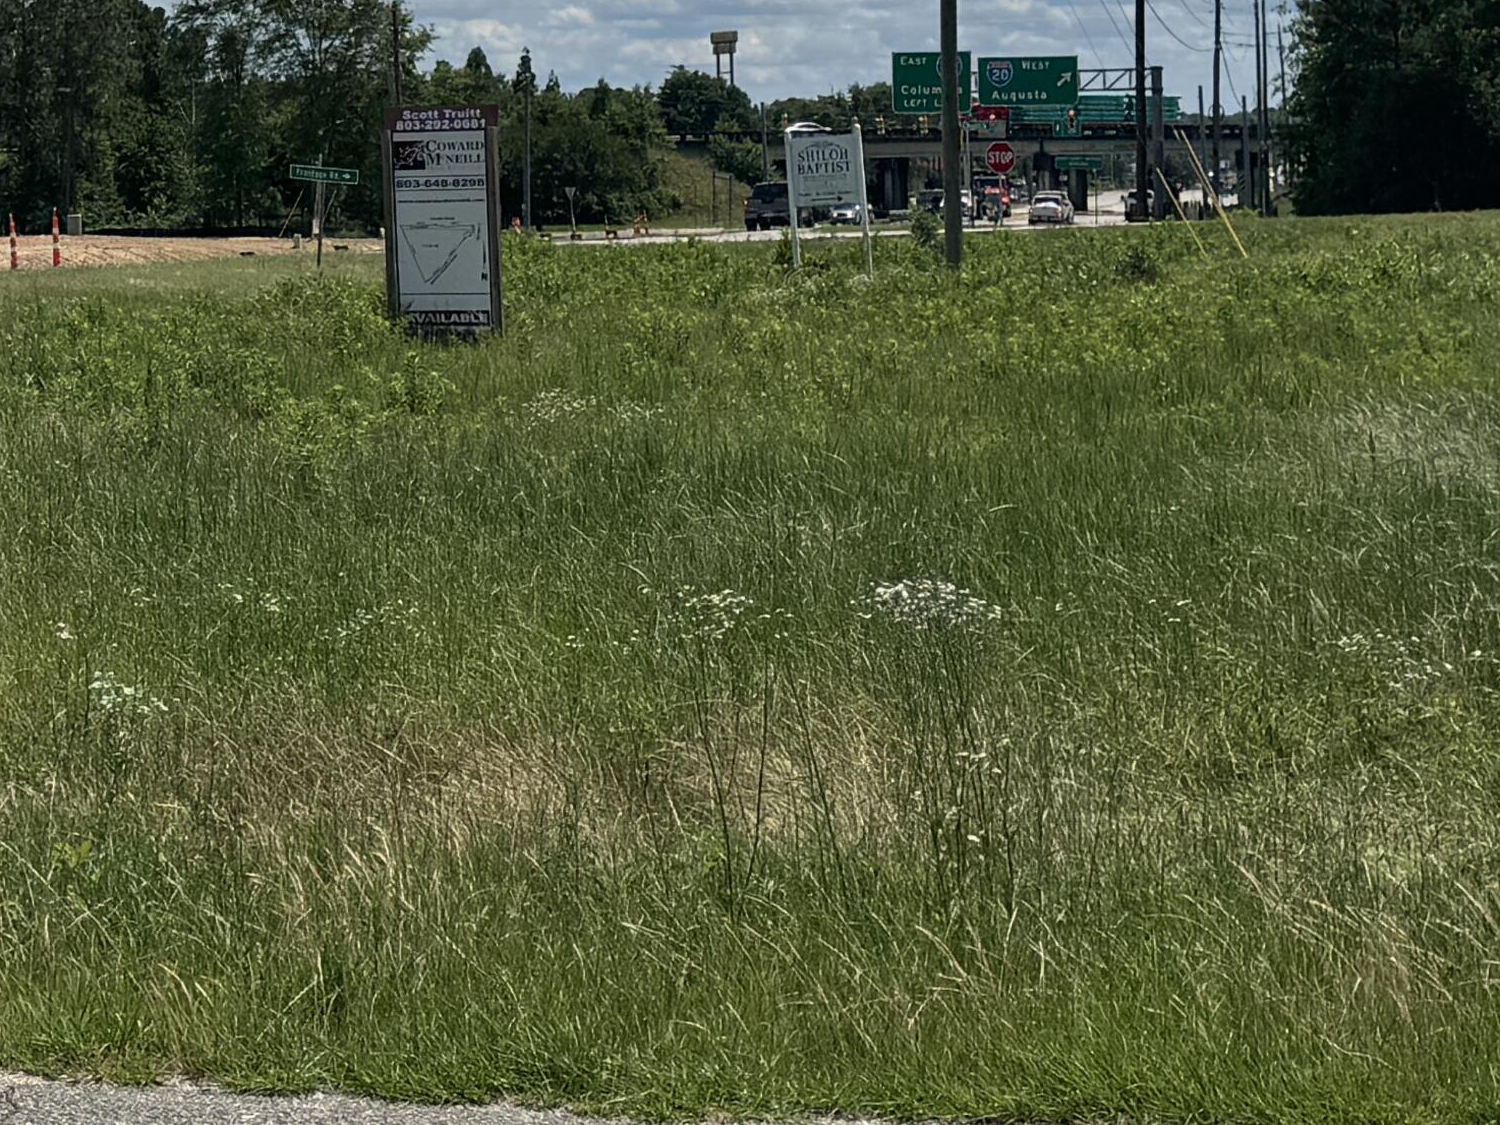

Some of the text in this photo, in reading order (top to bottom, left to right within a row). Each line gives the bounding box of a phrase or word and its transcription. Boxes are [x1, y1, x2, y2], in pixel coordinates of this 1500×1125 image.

[900, 56, 927, 66] EAST
[1021, 60, 1050, 70] WEST
[991, 69, 1009, 81] 20
[901, 85, 963, 95] Columa
[991, 90, 1048, 102] Augusta
[402, 108, 481, 120] Scott Truitt
[426, 139, 484, 153] COWARD
[797, 148, 848, 162] SHILOH
[988, 151, 1013, 164] STOP
[797, 161, 851, 175] BAPTIST
